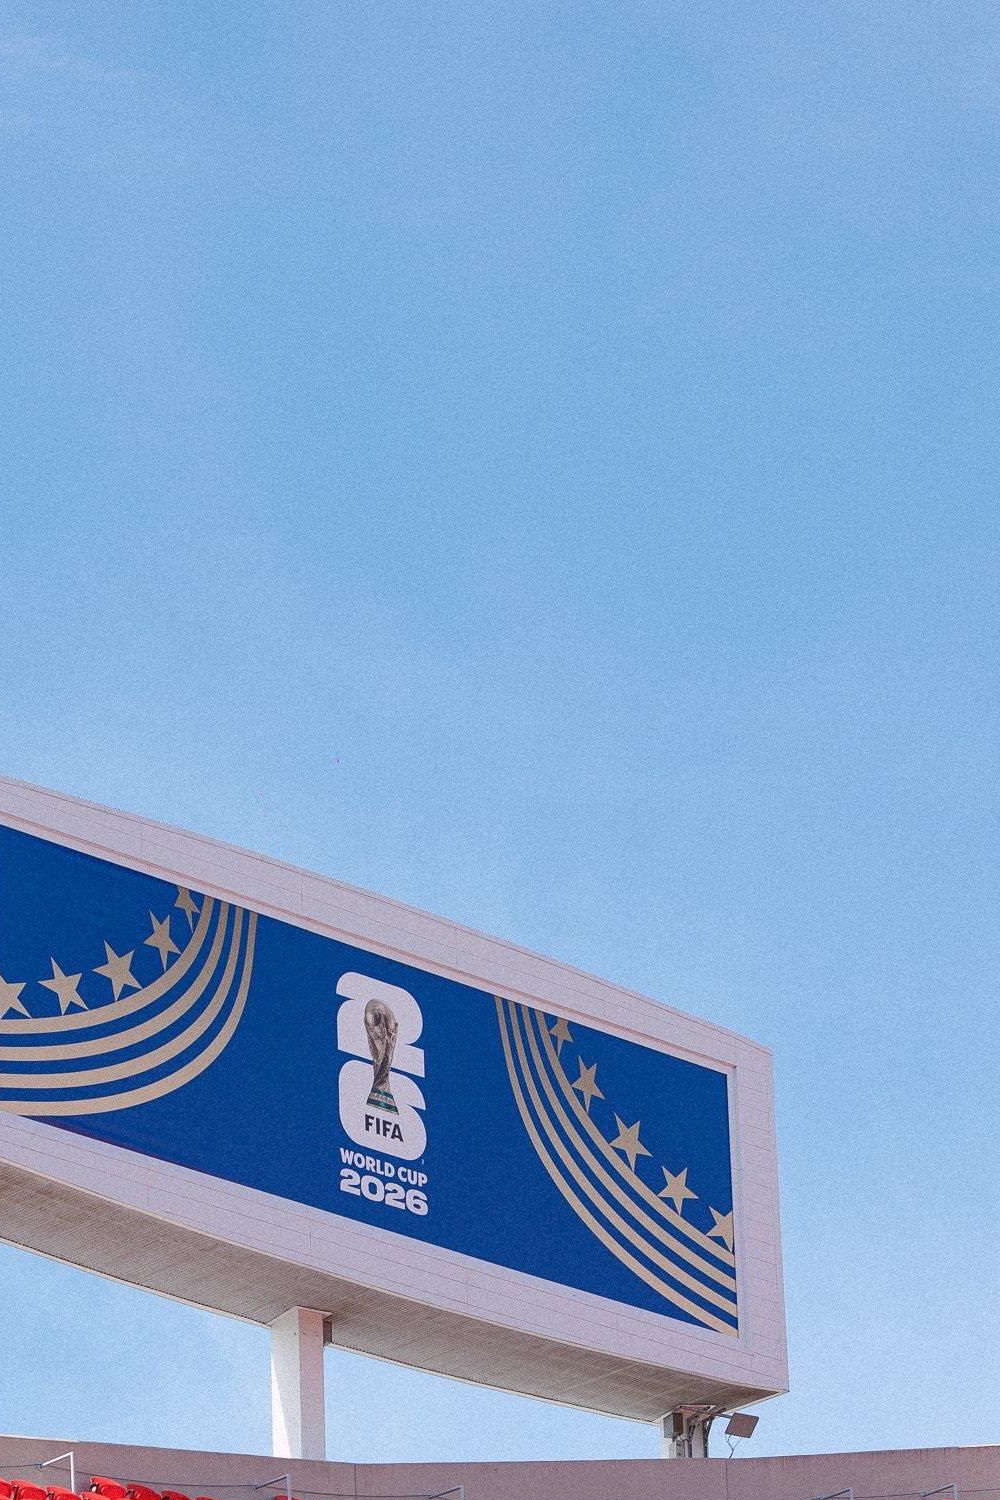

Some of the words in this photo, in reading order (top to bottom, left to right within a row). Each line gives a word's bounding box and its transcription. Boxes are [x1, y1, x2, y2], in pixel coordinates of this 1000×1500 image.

[364, 1113, 404, 1143] FIFA
[339, 1147, 396, 1178] WORLD
[397, 1165, 428, 1187] CUP
[339, 1168, 429, 1216] 2026
